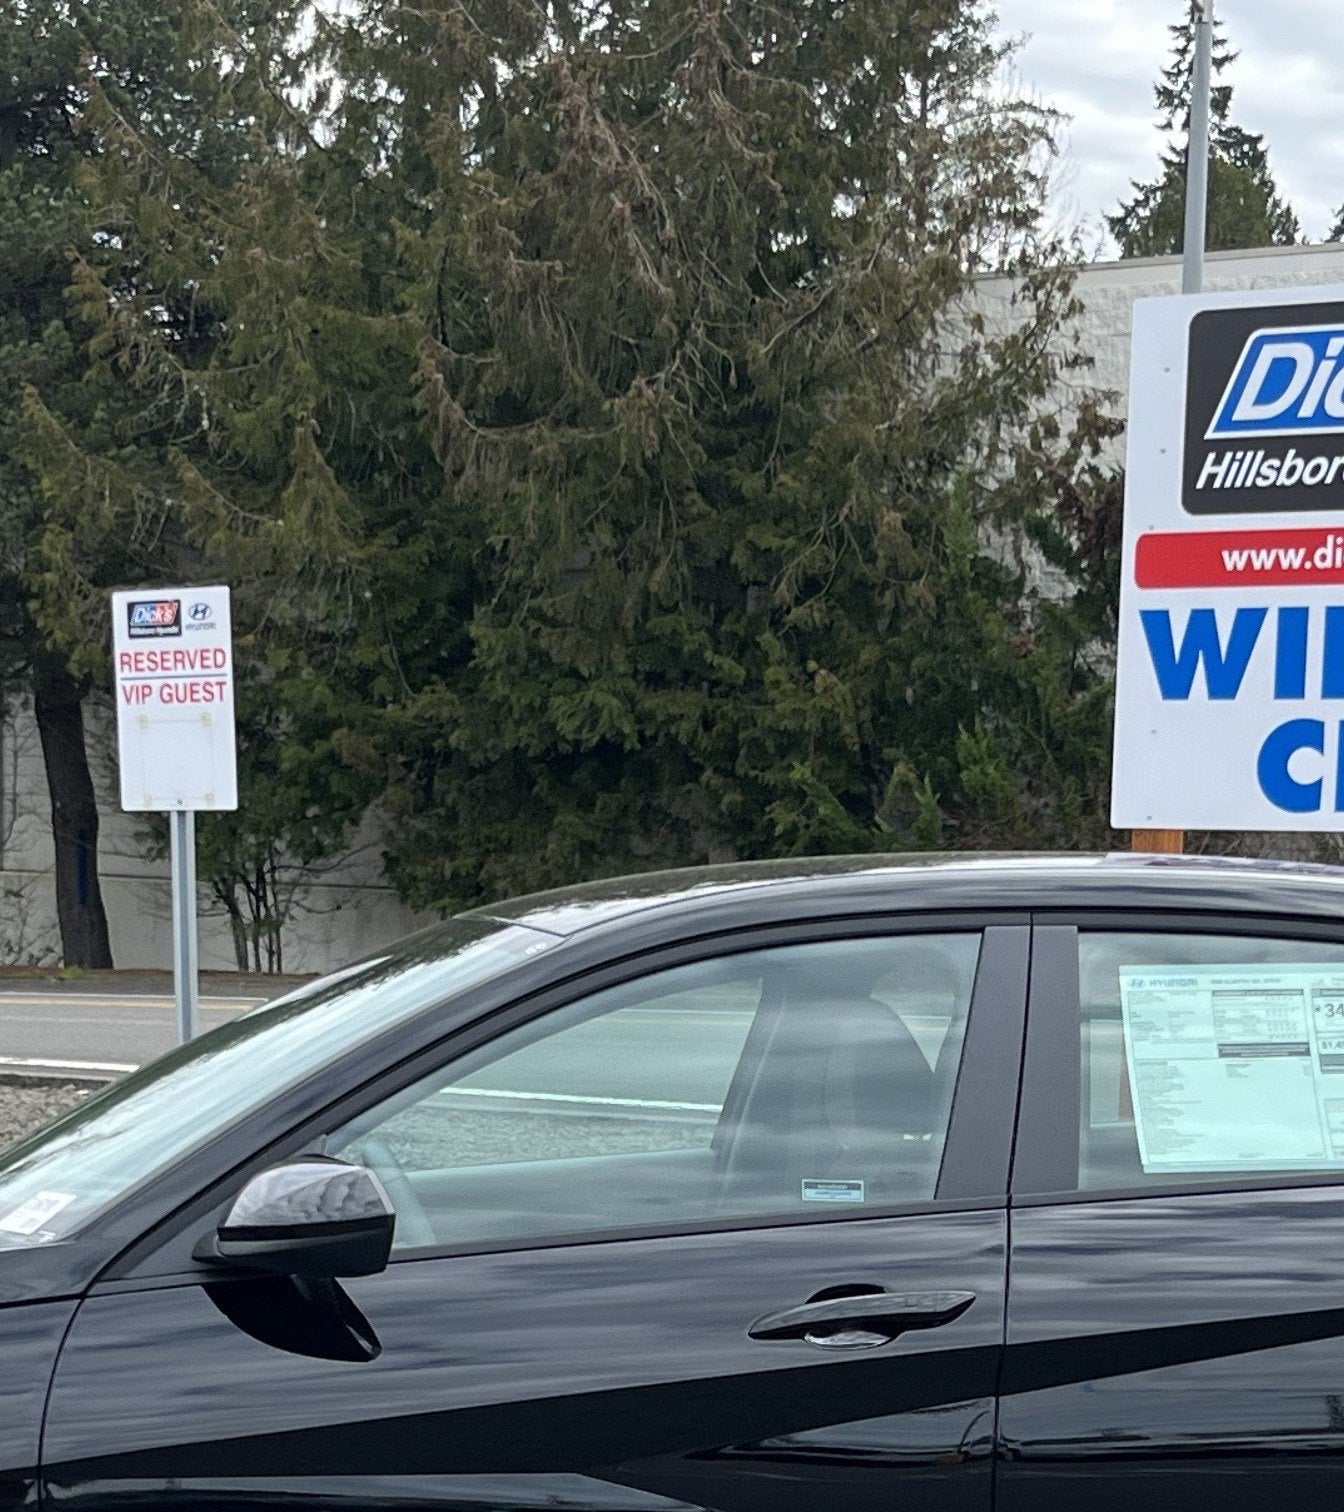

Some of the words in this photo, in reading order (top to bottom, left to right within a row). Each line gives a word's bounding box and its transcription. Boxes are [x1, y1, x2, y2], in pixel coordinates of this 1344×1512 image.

[120, 647, 226, 673] RESERVED
[122, 684, 152, 706] VIP
[159, 681, 227, 705] GUEST
